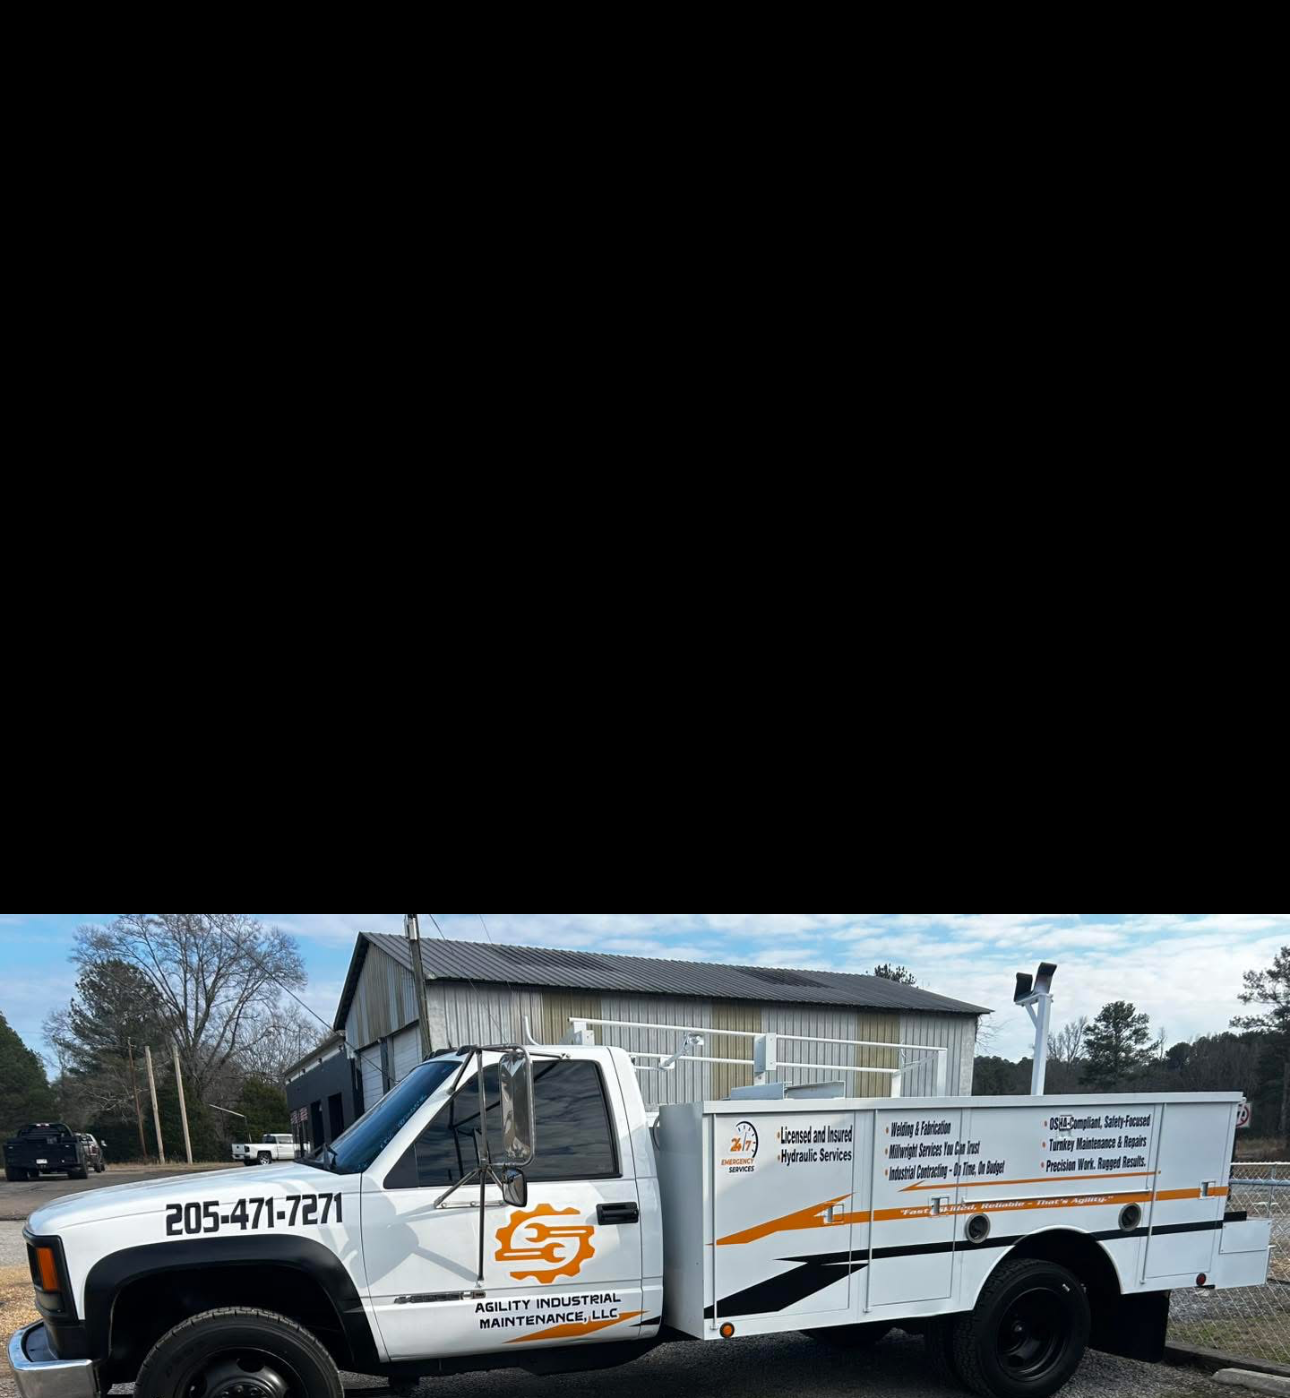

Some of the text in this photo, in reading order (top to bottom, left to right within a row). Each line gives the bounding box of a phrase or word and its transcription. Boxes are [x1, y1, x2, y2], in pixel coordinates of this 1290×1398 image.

[891, 1120, 951, 1138] Welding & Fabrication
[1104, 1114, 1151, 1129] Safety-Focused
[730, 1132, 751, 1151] 24/7
[781, 1125, 852, 1144] Licensed and Insured
[1049, 1135, 1146, 1152] Turnkey Maintenance & Repairs
[781, 1148, 852, 1166] Hydraulic Services
[889, 1140, 980, 1160] Millwright Services You Can Trust
[721, 1158, 754, 1166] EMERGENCY
[729, 1166, 755, 1174] SERVICES
[889, 1165, 916, 1180] Industrial
[916, 1164, 948, 1179] Contracting
[954, 1162, 962, 1176] On
[962, 1162, 976, 1176] Time,
[978, 1161, 985, 1174] On
[986, 1160, 1005, 1175] Budget
[1046, 1155, 1146, 1172] Precision Work. Rugged Results.
[166, 1192, 342, 1236] 205-471-7271
[475, 1292, 621, 1313] AGILITY INDUSTRIAL
[480, 1308, 618, 1329] MAINTENANCE, LLC
